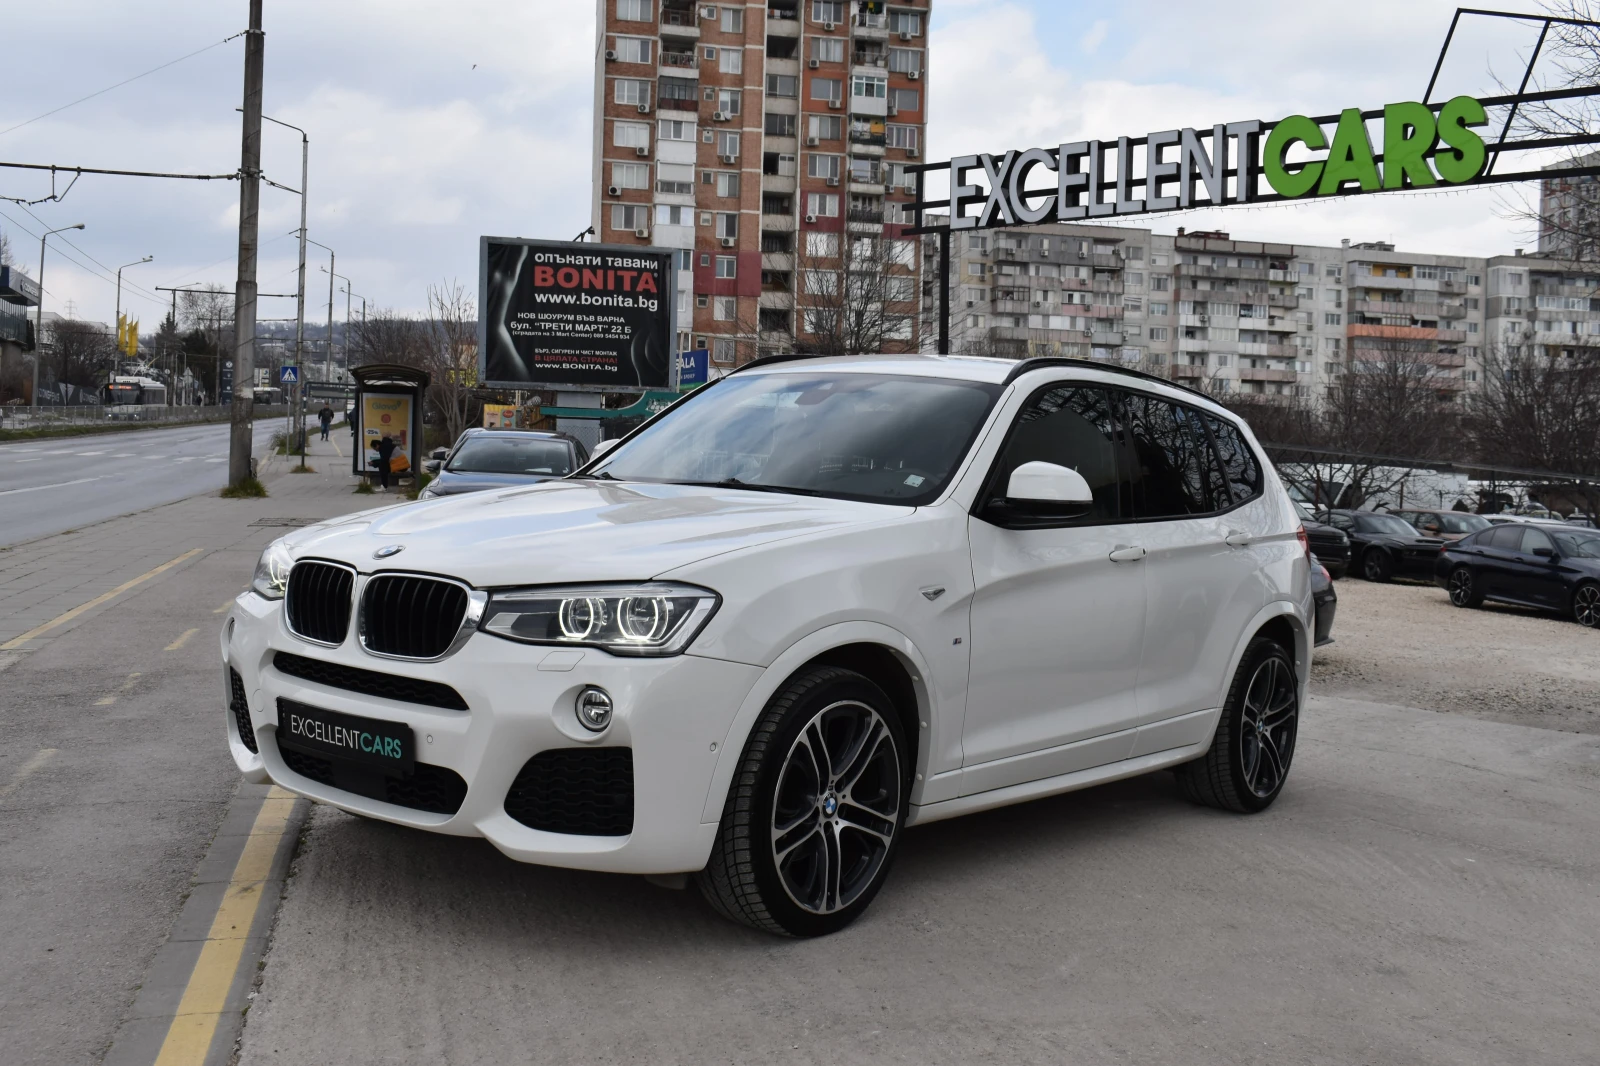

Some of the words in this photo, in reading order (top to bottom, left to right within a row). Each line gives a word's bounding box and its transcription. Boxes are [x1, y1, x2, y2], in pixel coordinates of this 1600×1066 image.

[535, 253, 601, 265] опънати
[606, 257, 657, 269] тавани
[535, 293, 658, 312] www.bonita.bg
[510, 321, 531, 330] бул.
[535, 363, 617, 372] www.BONITA.bg
[372, 401, 400, 410] Glovo
